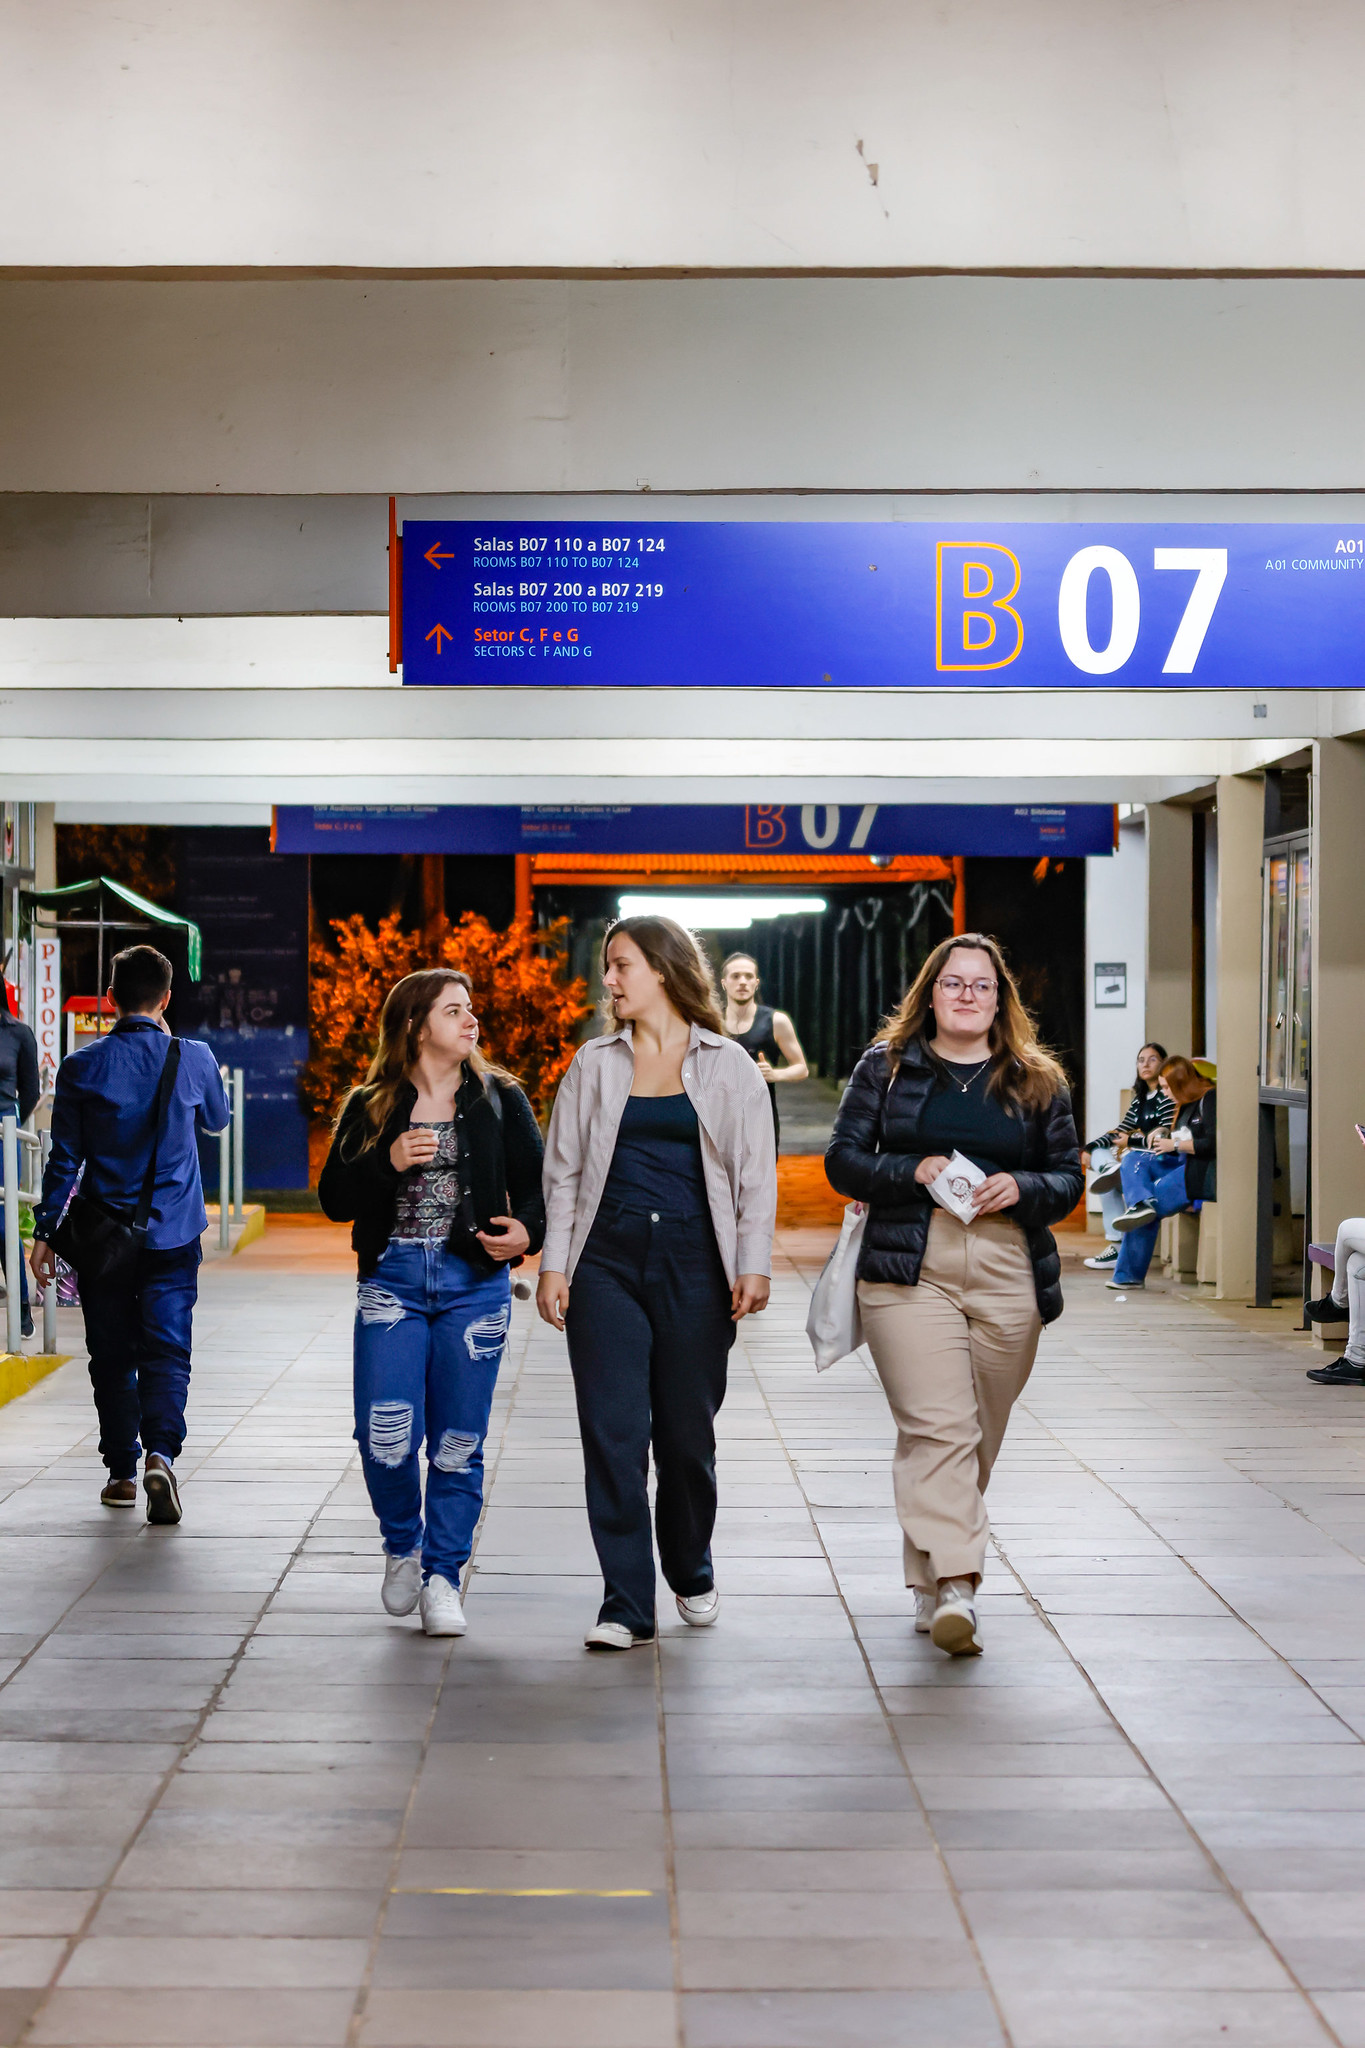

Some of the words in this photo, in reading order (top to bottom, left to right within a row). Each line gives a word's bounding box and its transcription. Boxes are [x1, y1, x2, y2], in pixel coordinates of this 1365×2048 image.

[473, 537, 514, 552] Salas
[519, 537, 548, 552] B07
[554, 537, 583, 552] 110
[587, 540, 597, 552] a
[602, 537, 631, 552] B07
[636, 537, 666, 552] 124
[1334, 539, 1365, 554] A01
[473, 556, 517, 568] ROOMS
[521, 556, 542, 568] B07
[547, 556, 569, 568] 110
[572, 556, 588, 568] TO
[592, 556, 613, 568] B07
[617, 556, 640, 568] 124
[1265, 559, 1287, 571] A01
[1290, 559, 1365, 571] COMMUNITY
[473, 582, 514, 597] Salas
[519, 582, 548, 597] B07
[553, 582, 583, 597] 200
[586, 585, 597, 597] a
[601, 582, 630, 597] B07
[634, 582, 664, 597] 219
[473, 601, 517, 613] ROOMS
[521, 601, 542, 613] B07
[546, 601, 568, 613] 200
[572, 601, 588, 613] TO
[592, 601, 613, 613] B07
[617, 601, 639, 613] 219
[935, 541, 1024, 672] B
[1058, 545, 1229, 675] 07
[473, 627, 515, 642] Setor
[519, 627, 534, 644] C,
[539, 627, 549, 642] F
[552, 630, 563, 642] e
[566, 627, 579, 642] G
[474, 645, 525, 657] SECTORS
[528, 645, 537, 657] C
[543, 645, 550, 657] F
[553, 645, 580, 657] AND
[583, 645, 592, 657] G
[745, 805, 787, 848] B
[801, 805, 879, 849] 07
